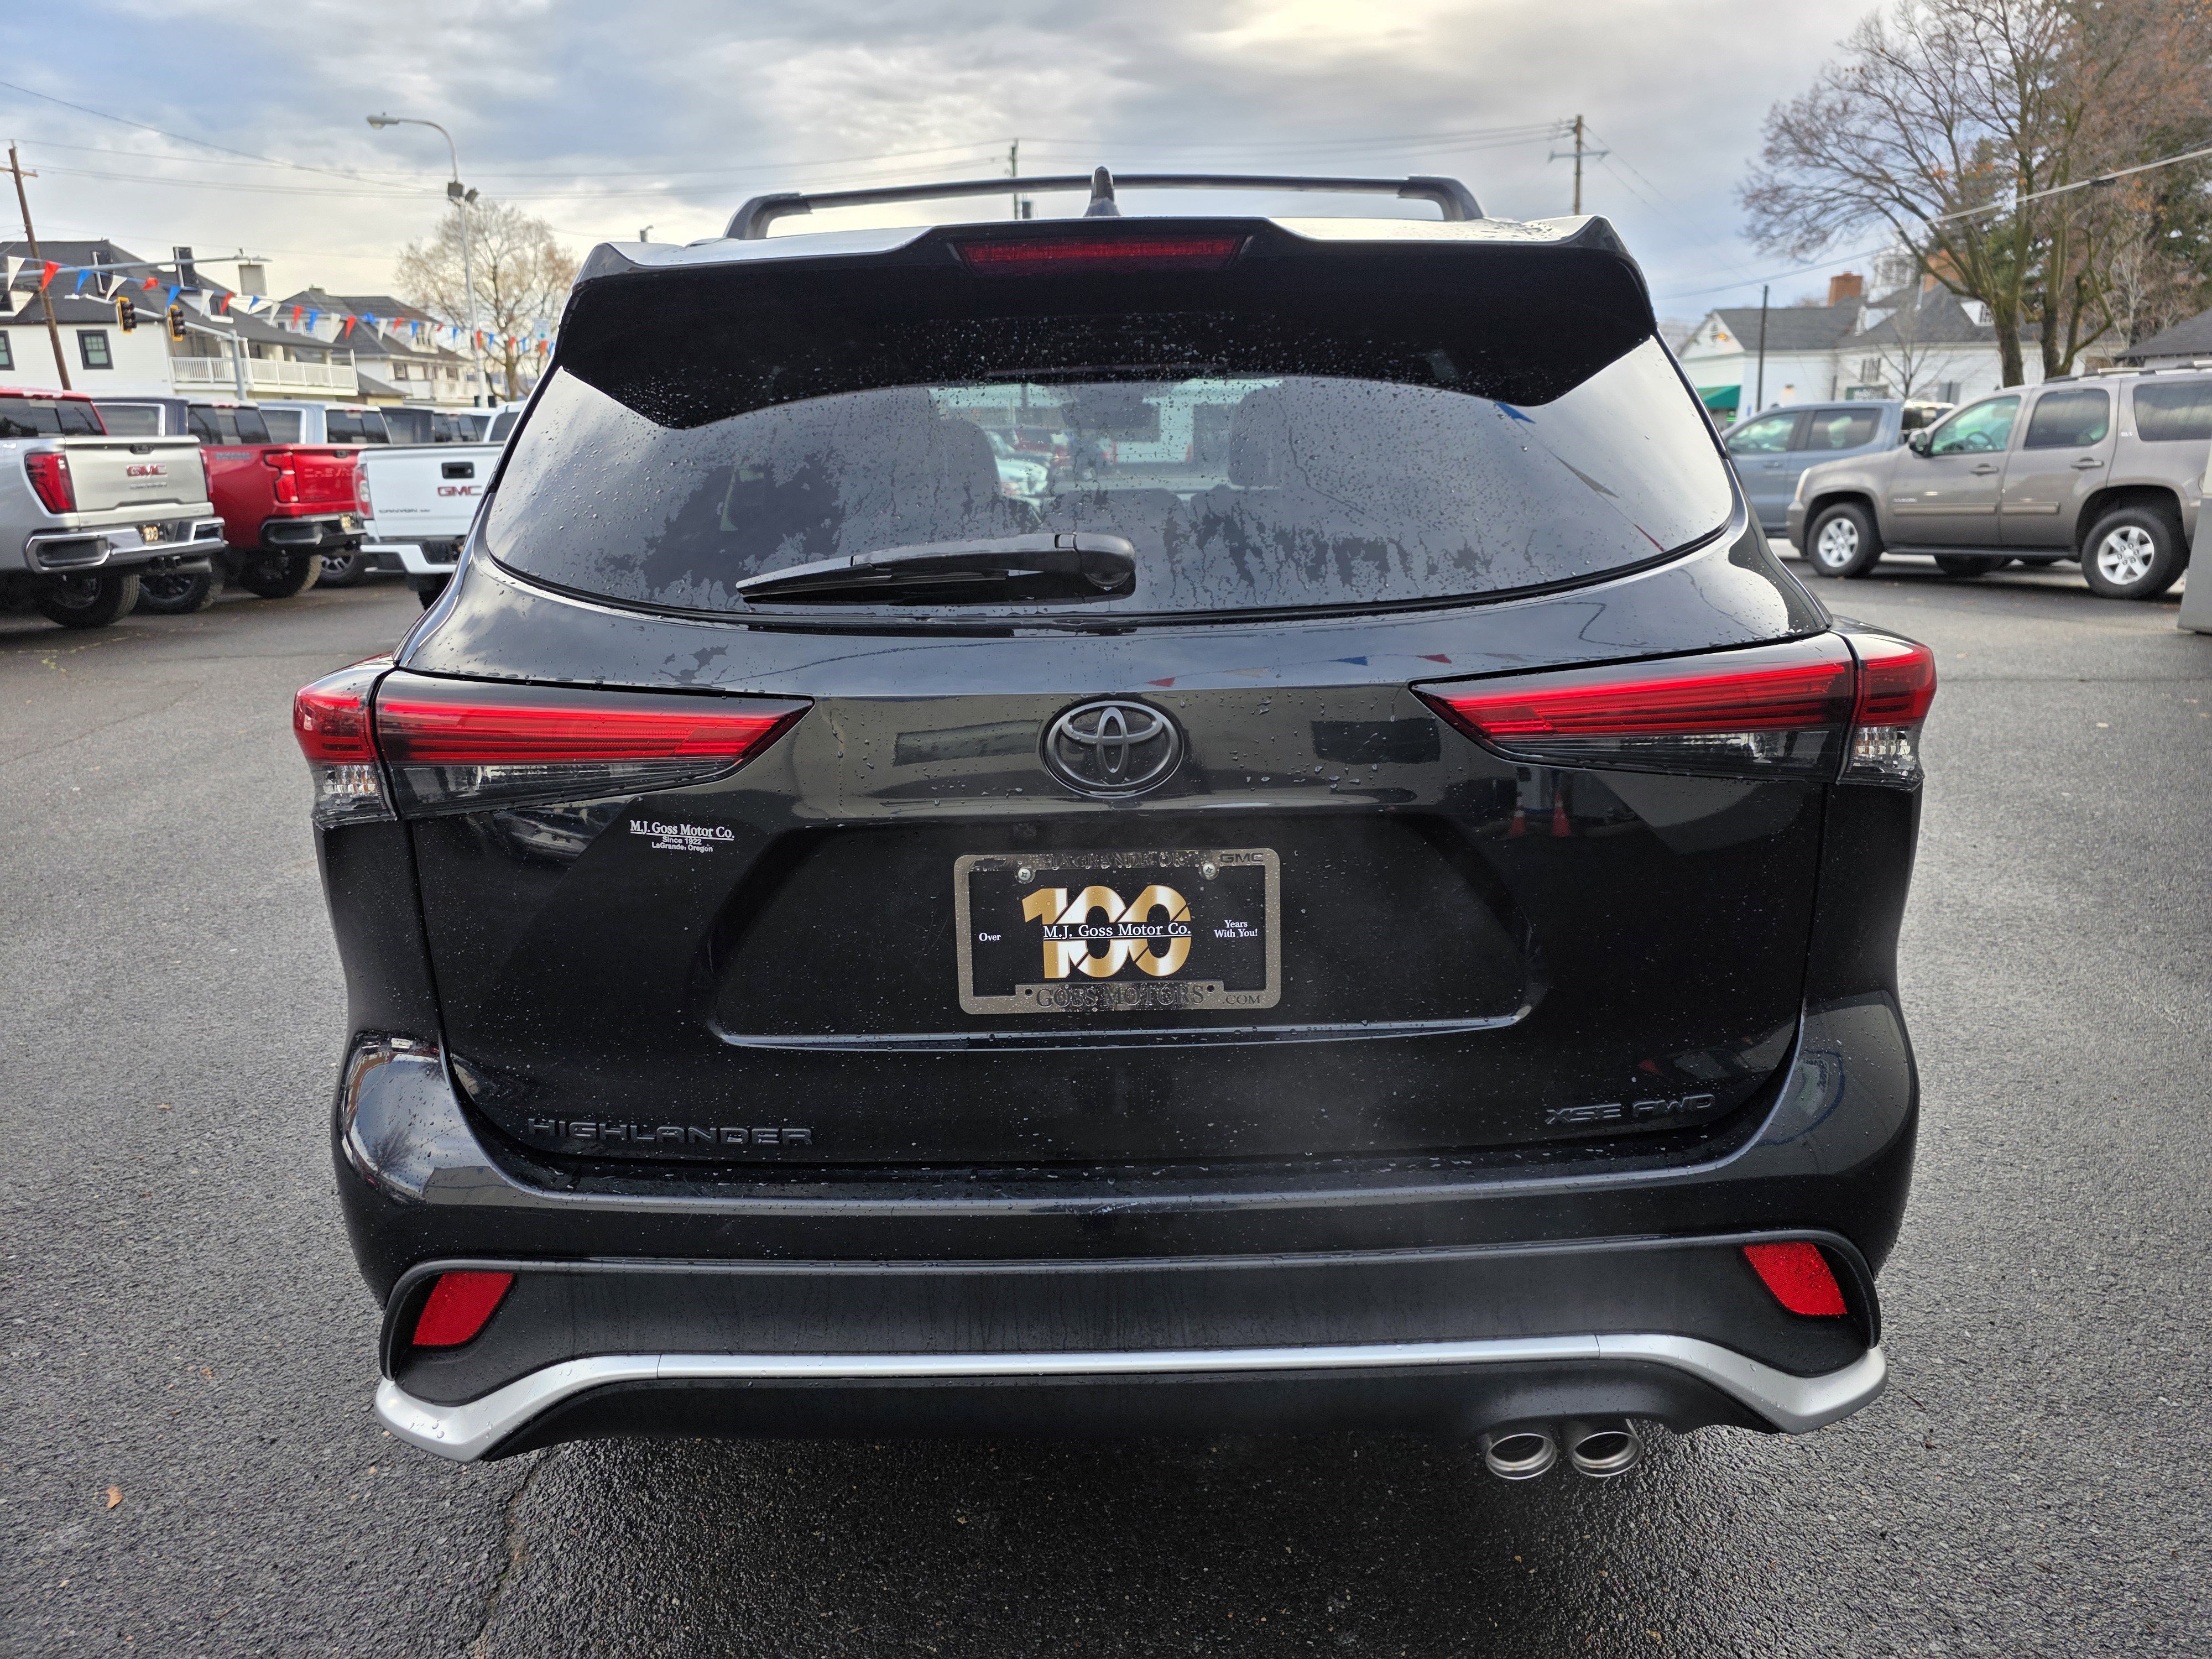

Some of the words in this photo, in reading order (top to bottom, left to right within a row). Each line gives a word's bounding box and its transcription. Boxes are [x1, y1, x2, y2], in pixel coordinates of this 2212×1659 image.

[127, 463, 168, 477] GMC
[437, 486, 482, 496] GMC
[630, 820, 650, 834] M.J.
[651, 822, 677, 834] Goss
[680, 824, 713, 837] Motor
[716, 826, 735, 838] Co.
[651, 842, 686, 851] LaGrande,
[687, 844, 713, 853] Oregon
[1220, 852, 1264, 863] GMC
[1224, 919, 1248, 928] Years
[979, 932, 1001, 941] Over
[1022, 885, 1192, 978] 100
[1043, 925, 1072, 939] M.J.
[1078, 925, 1113, 936] Goss
[1118, 923, 1163, 936] Motor
[1168, 922, 1191, 935] Co.
[1214, 928, 1235, 938] With
[1238, 928, 1258, 937] You!
[1036, 988, 1097, 1008] GOSS
[1105, 984, 1204, 1006] MOTORS
[1222, 994, 1261, 1005] .COM
[1545, 1103, 1622, 1124] XSE
[1632, 1094, 1715, 1117] AWD
[528, 1117, 813, 1145] HIGHLANDER
